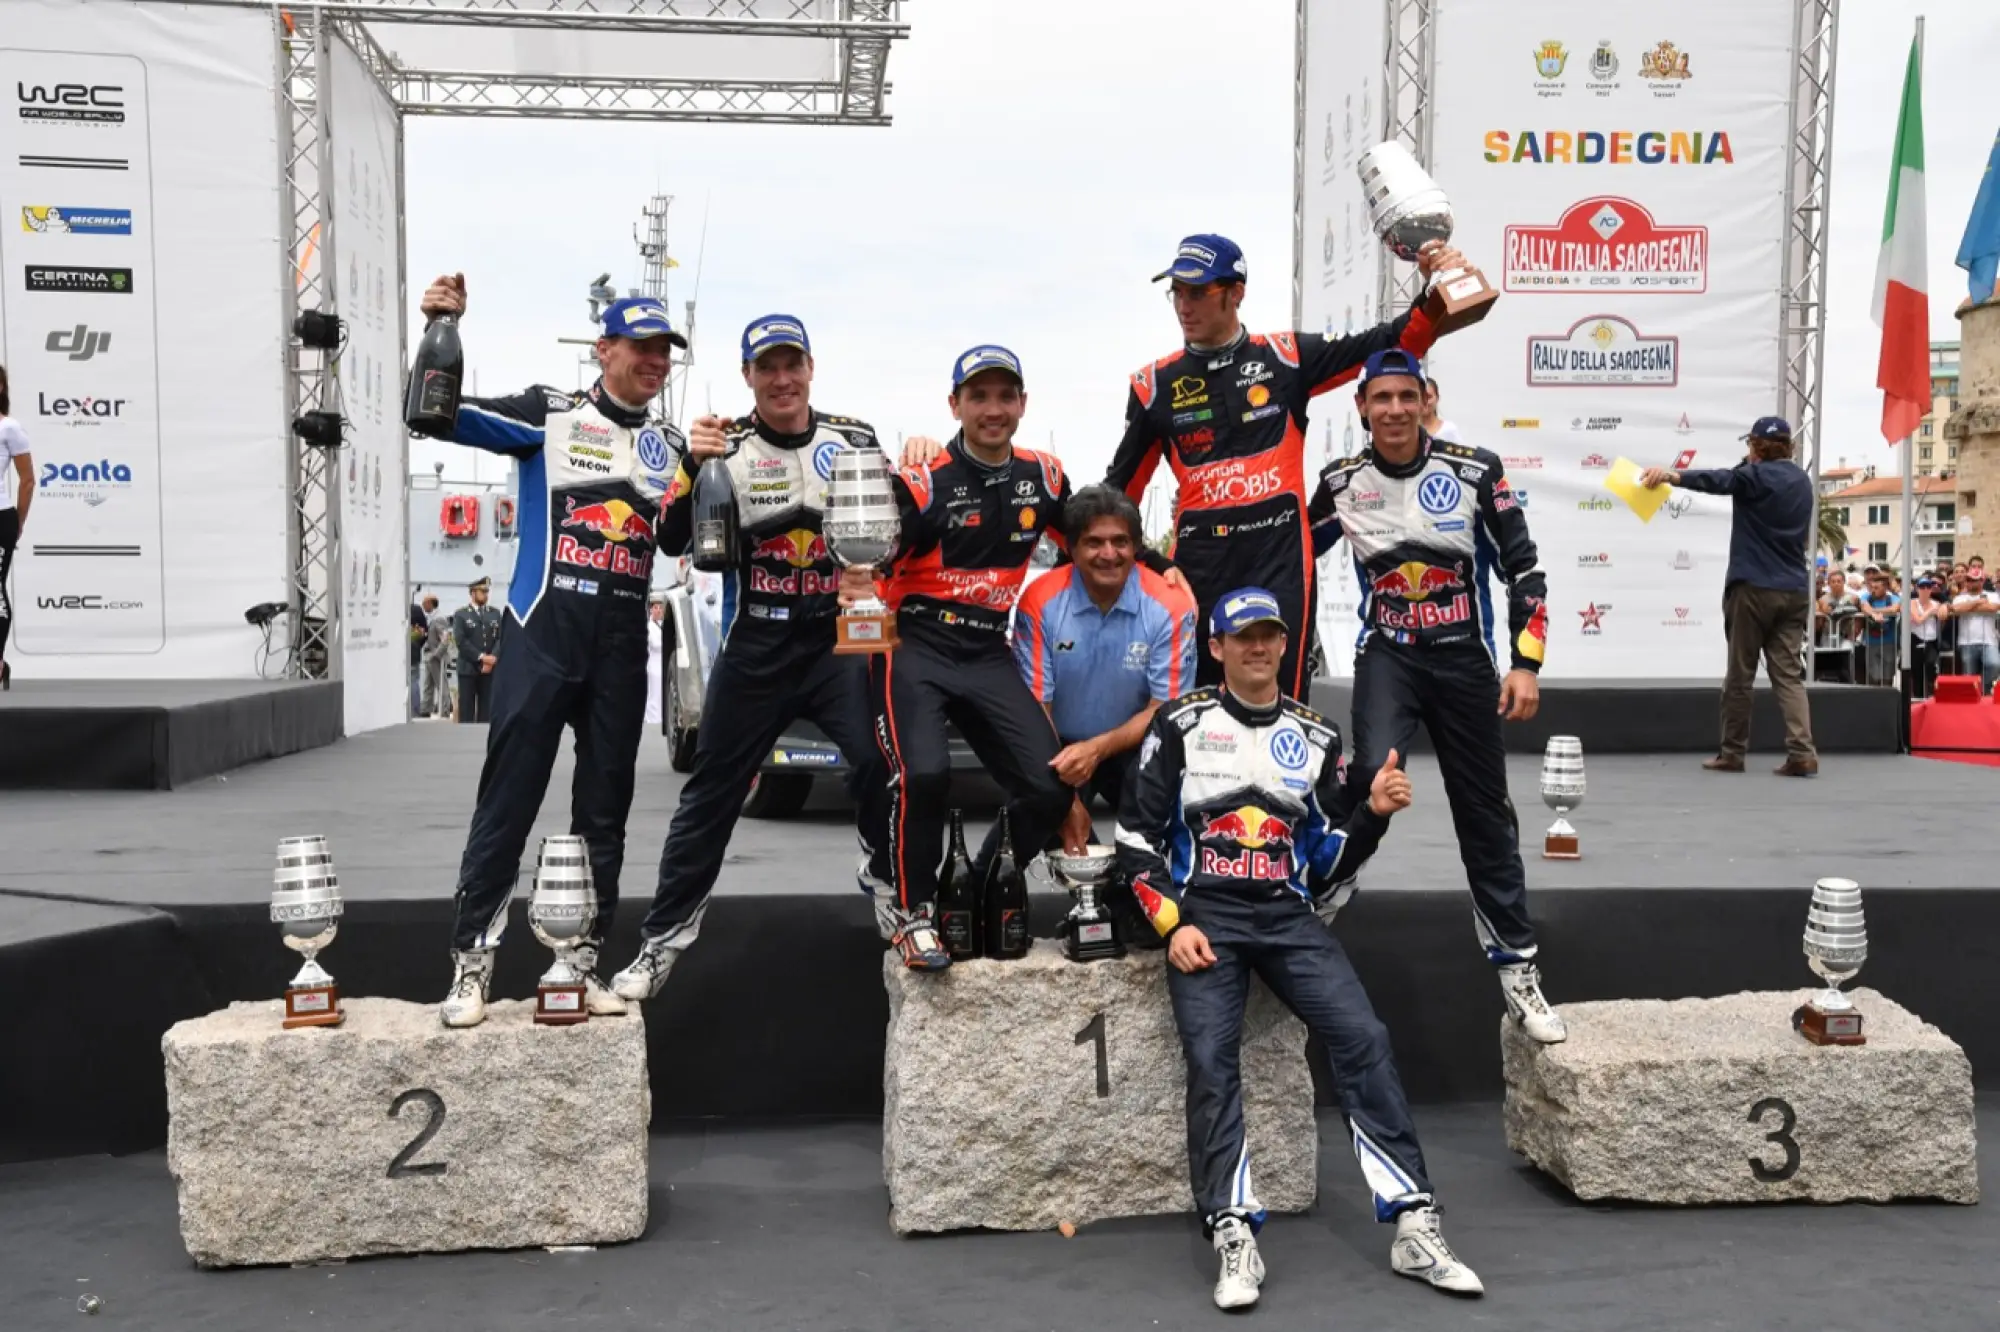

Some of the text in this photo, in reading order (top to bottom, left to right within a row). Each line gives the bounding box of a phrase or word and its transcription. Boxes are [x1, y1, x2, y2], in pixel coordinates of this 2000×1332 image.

[18, 81, 124, 107] WRC
[1484, 130, 1734, 164] SARDEGNA
[69, 215, 131, 226] MICHELIN
[1508, 230, 1702, 272] RALLY ITALIA SARDEGNA
[30, 269, 109, 282] CERTINA
[1533, 342, 1672, 371] RALLY DELLA SARDEGNA
[38, 391, 126, 417] Lexar
[40, 459, 132, 488] panta
[570, 457, 611, 474] VACON
[1187, 463, 1245, 485] HYUNDAI
[1202, 466, 1282, 504] MOBIS
[555, 533, 651, 580] Red Bull
[750, 564, 842, 596] Red Bul
[1376, 592, 1471, 630] Red Bull
[790, 752, 837, 762] MICHELIN
[1201, 849, 1290, 880] Red Bull
[1074, 1012, 1109, 1099] 1
[386, 1087, 447, 1179] 2
[1747, 1097, 1801, 1183] 3
